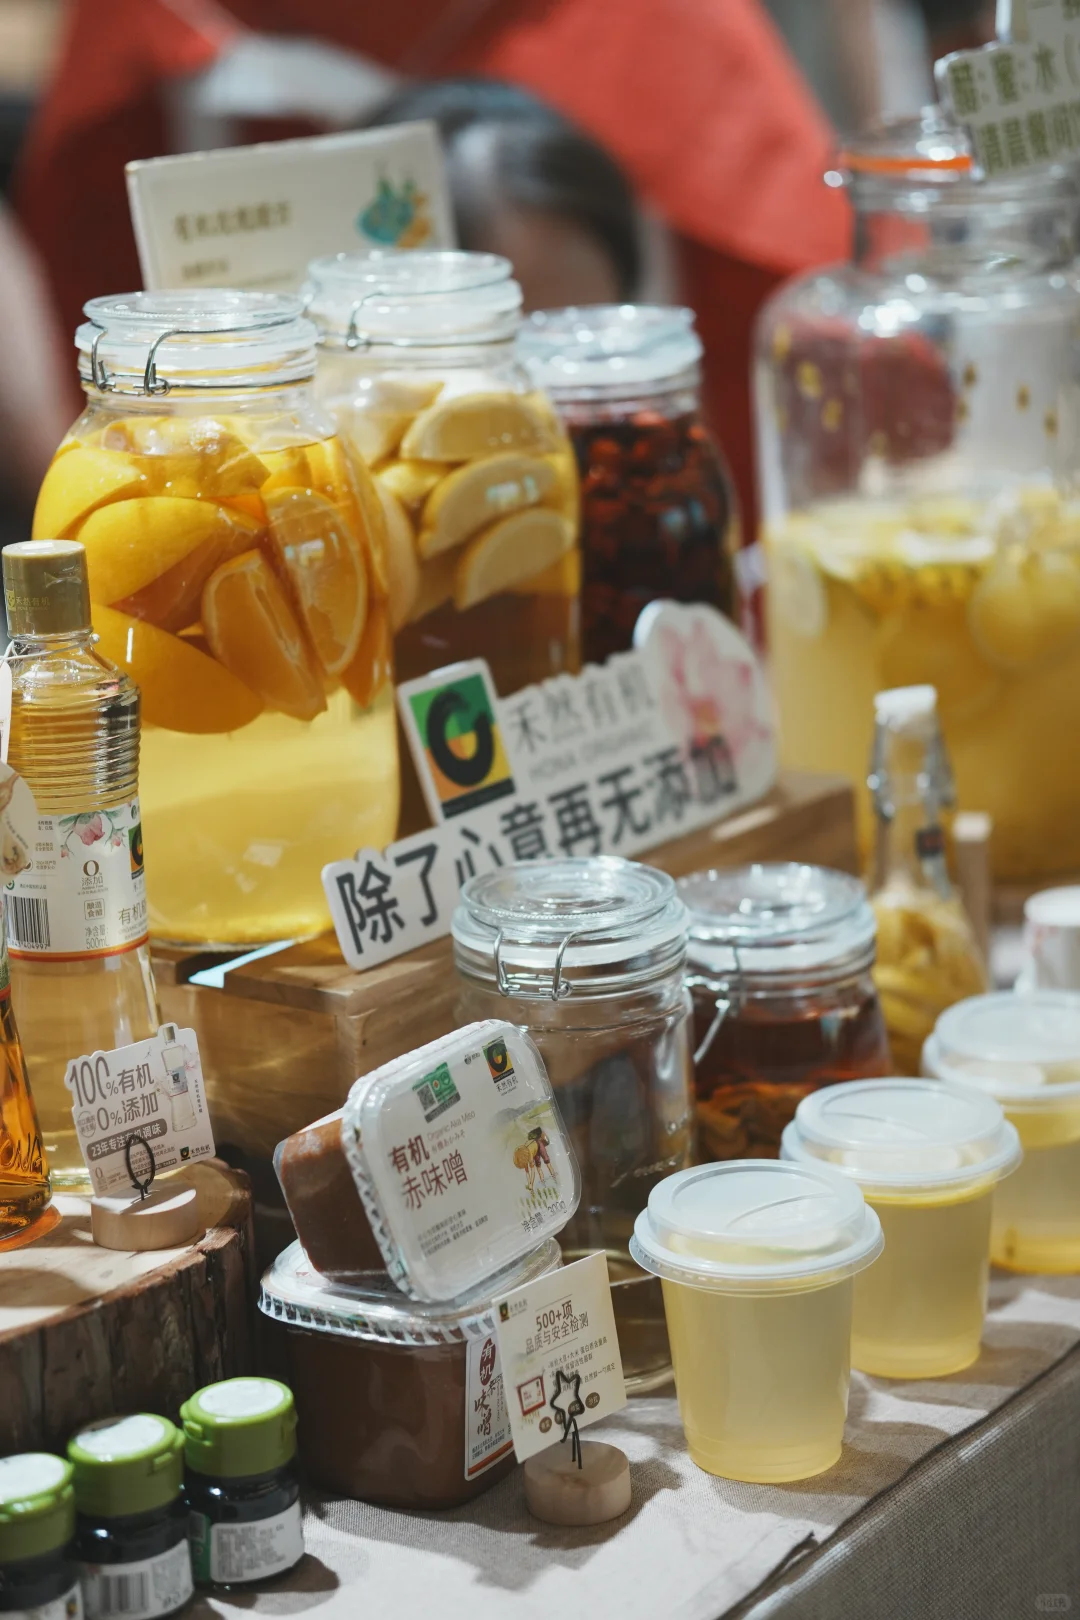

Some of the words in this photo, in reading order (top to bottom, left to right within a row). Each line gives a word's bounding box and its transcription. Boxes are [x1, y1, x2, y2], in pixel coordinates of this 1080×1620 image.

[389, 1136, 429, 1175] 有机
[402, 1150, 468, 1211] 赤味噌
[525, 1311, 589, 1355] 品质与安全检测
[481, 1342, 495, 1382] 有机
